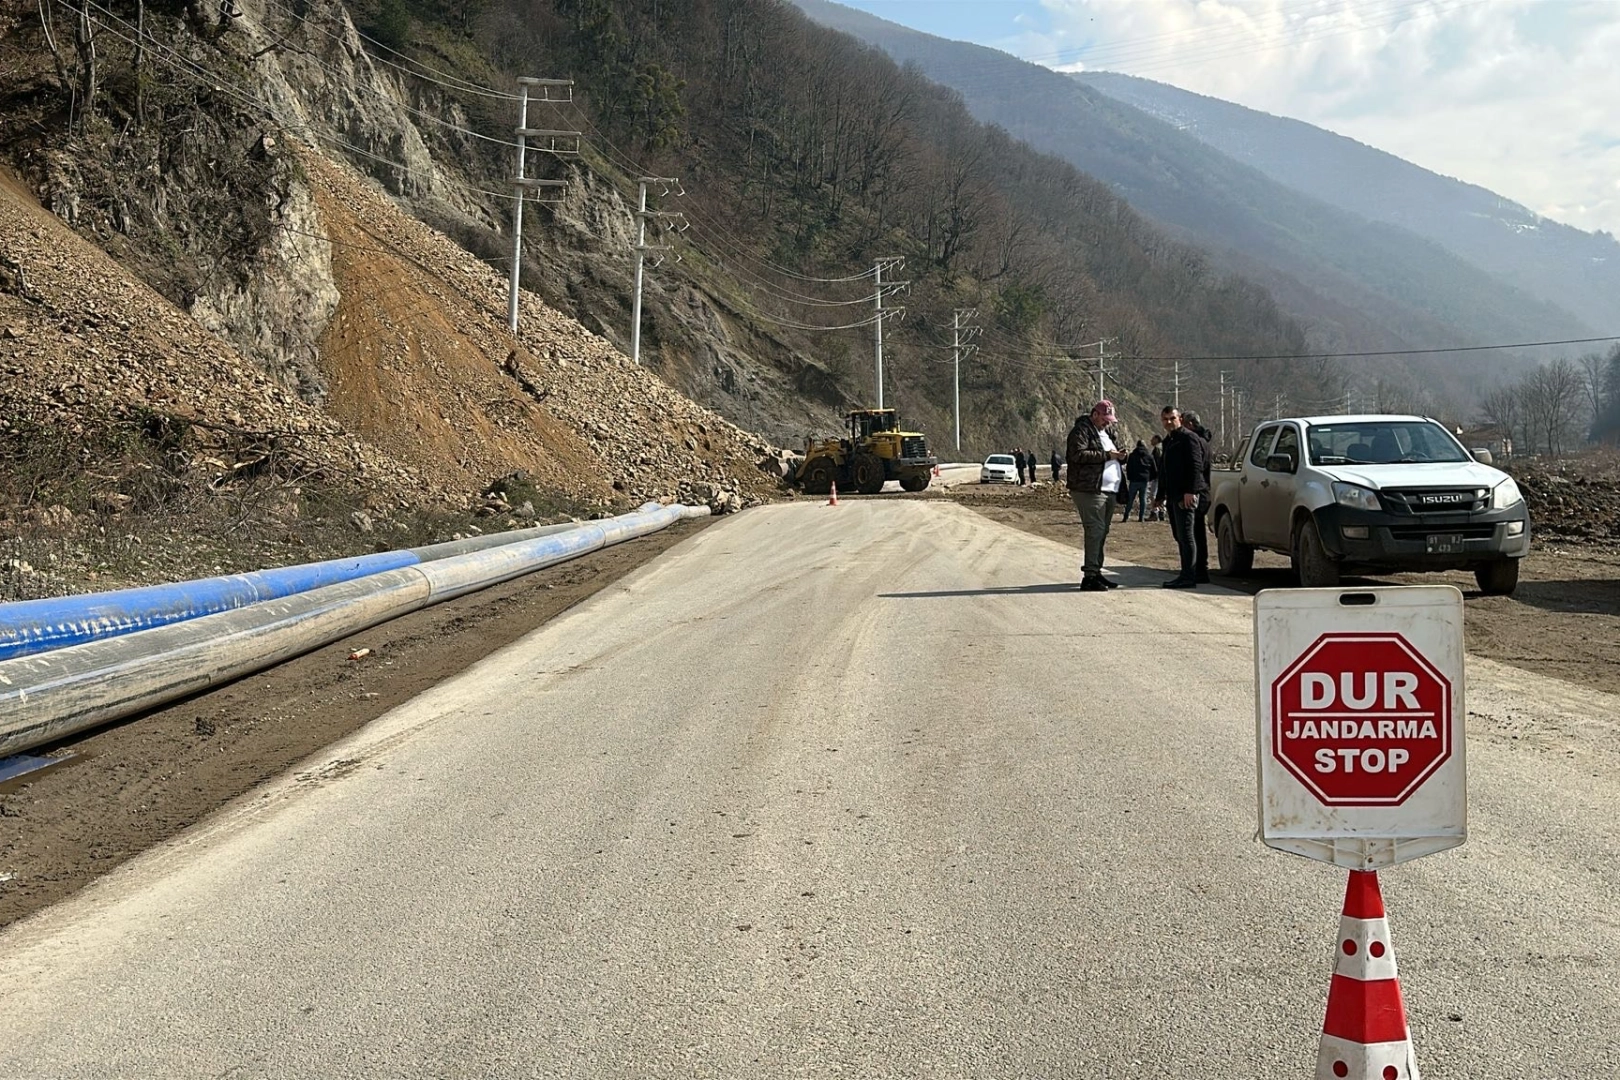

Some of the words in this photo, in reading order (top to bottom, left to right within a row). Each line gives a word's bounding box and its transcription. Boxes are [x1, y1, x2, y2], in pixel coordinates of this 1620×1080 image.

[1422, 495, 1459, 504] ISUZU
[1300, 671, 1421, 710] DUR
[1285, 720, 1437, 739] JANDARMA
[1314, 748, 1409, 773] STOP
